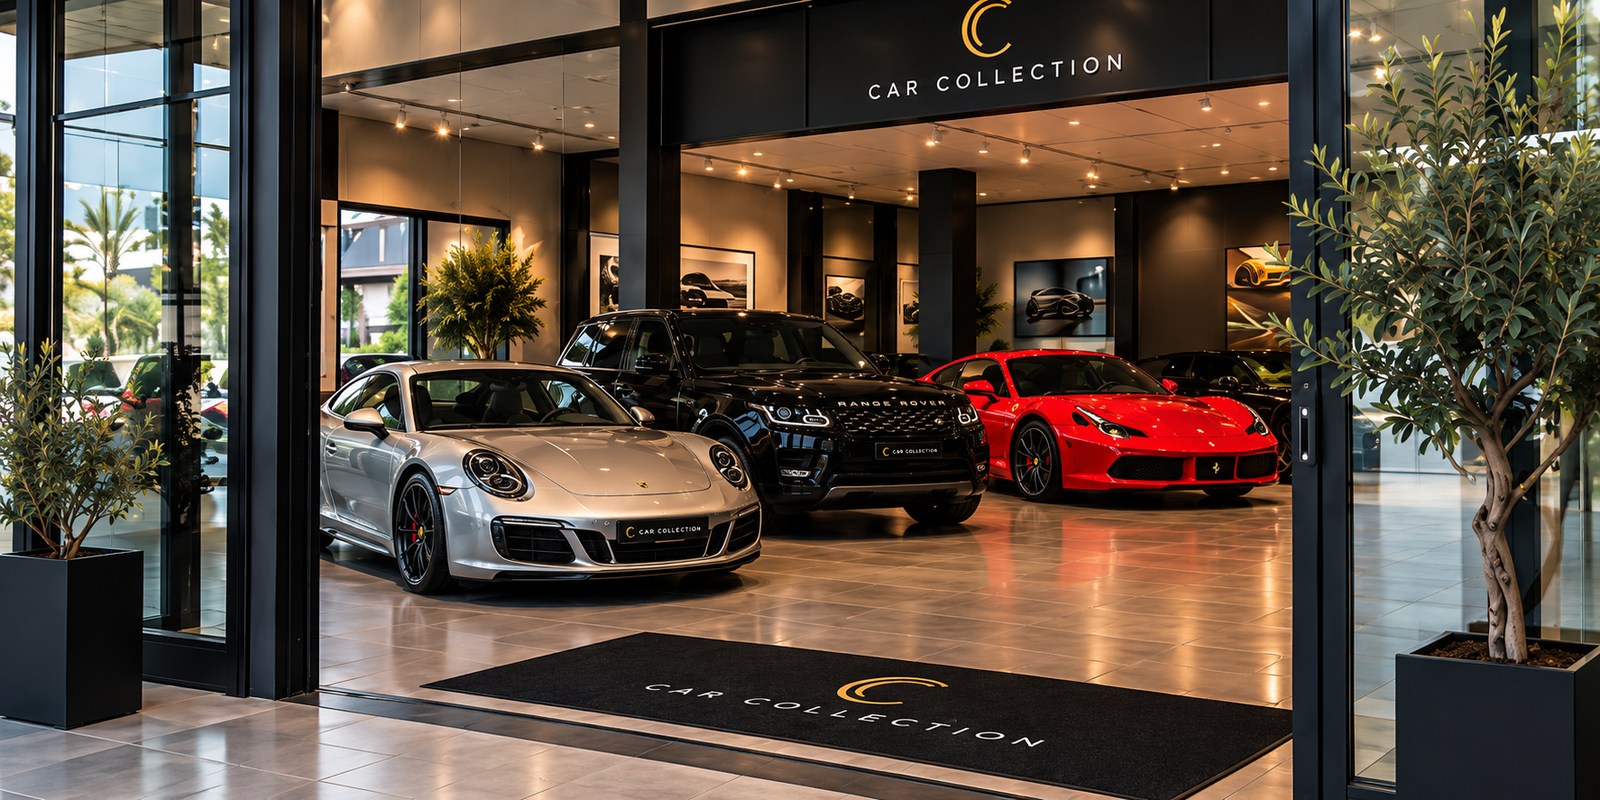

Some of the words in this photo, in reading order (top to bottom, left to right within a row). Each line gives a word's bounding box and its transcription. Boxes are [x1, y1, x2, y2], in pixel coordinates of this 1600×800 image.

[868, 80, 919, 100] CAR
[936, 53, 1123, 92] COLLECTION
[657, 526, 702, 534] COLLECTION
[645, 683, 724, 699] CAR
[743, 697, 1045, 748] COLLECTION
